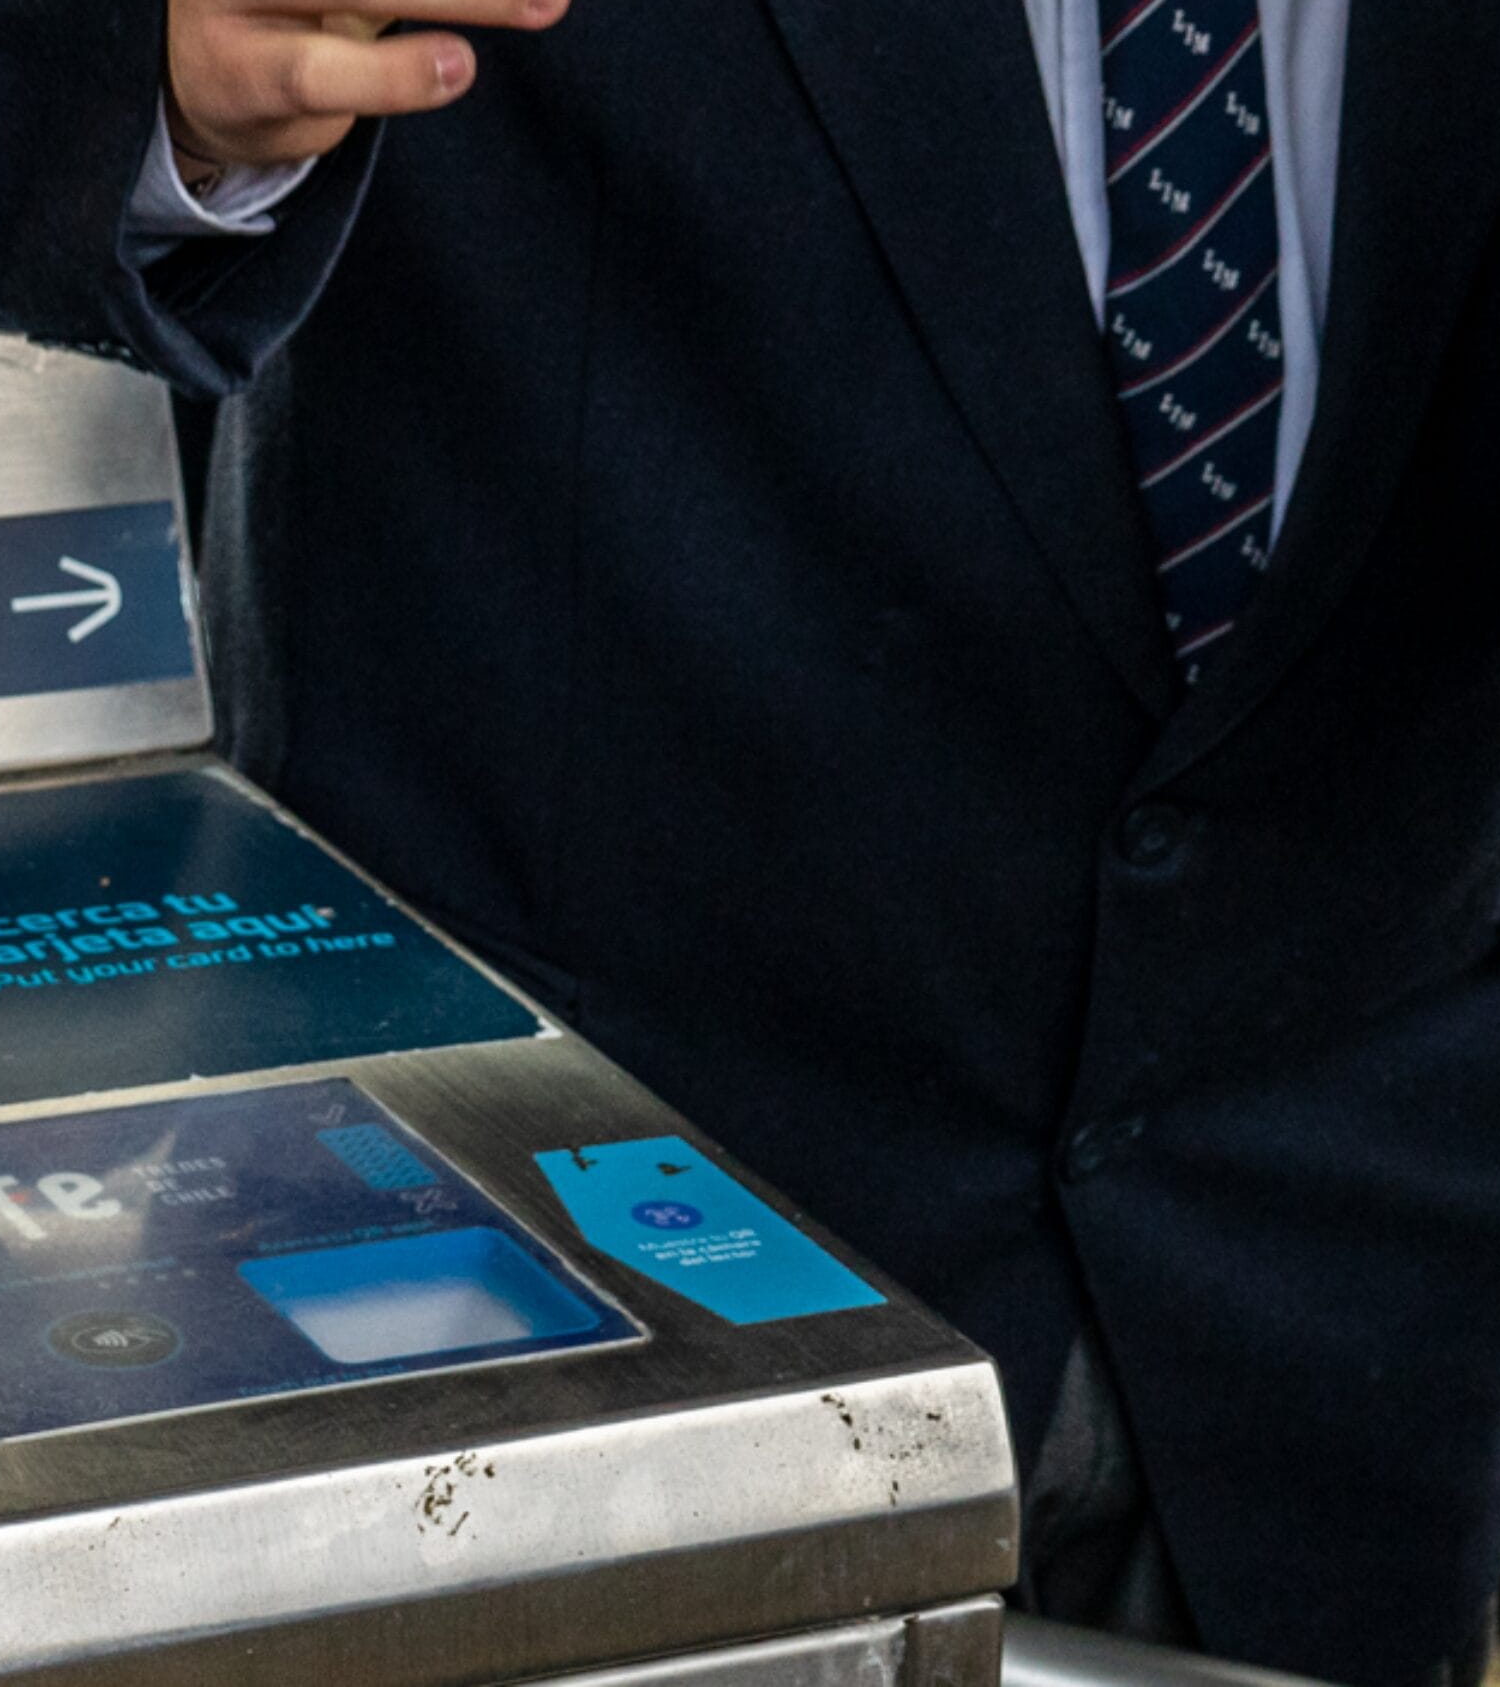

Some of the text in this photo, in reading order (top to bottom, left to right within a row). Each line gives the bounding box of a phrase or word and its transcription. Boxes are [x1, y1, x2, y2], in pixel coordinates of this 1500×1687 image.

[162, 892, 238, 915] tu
[66, 958, 157, 984] your
[165, 943, 253, 969] card
[258, 942, 300, 958] to
[304, 932, 395, 953] here
